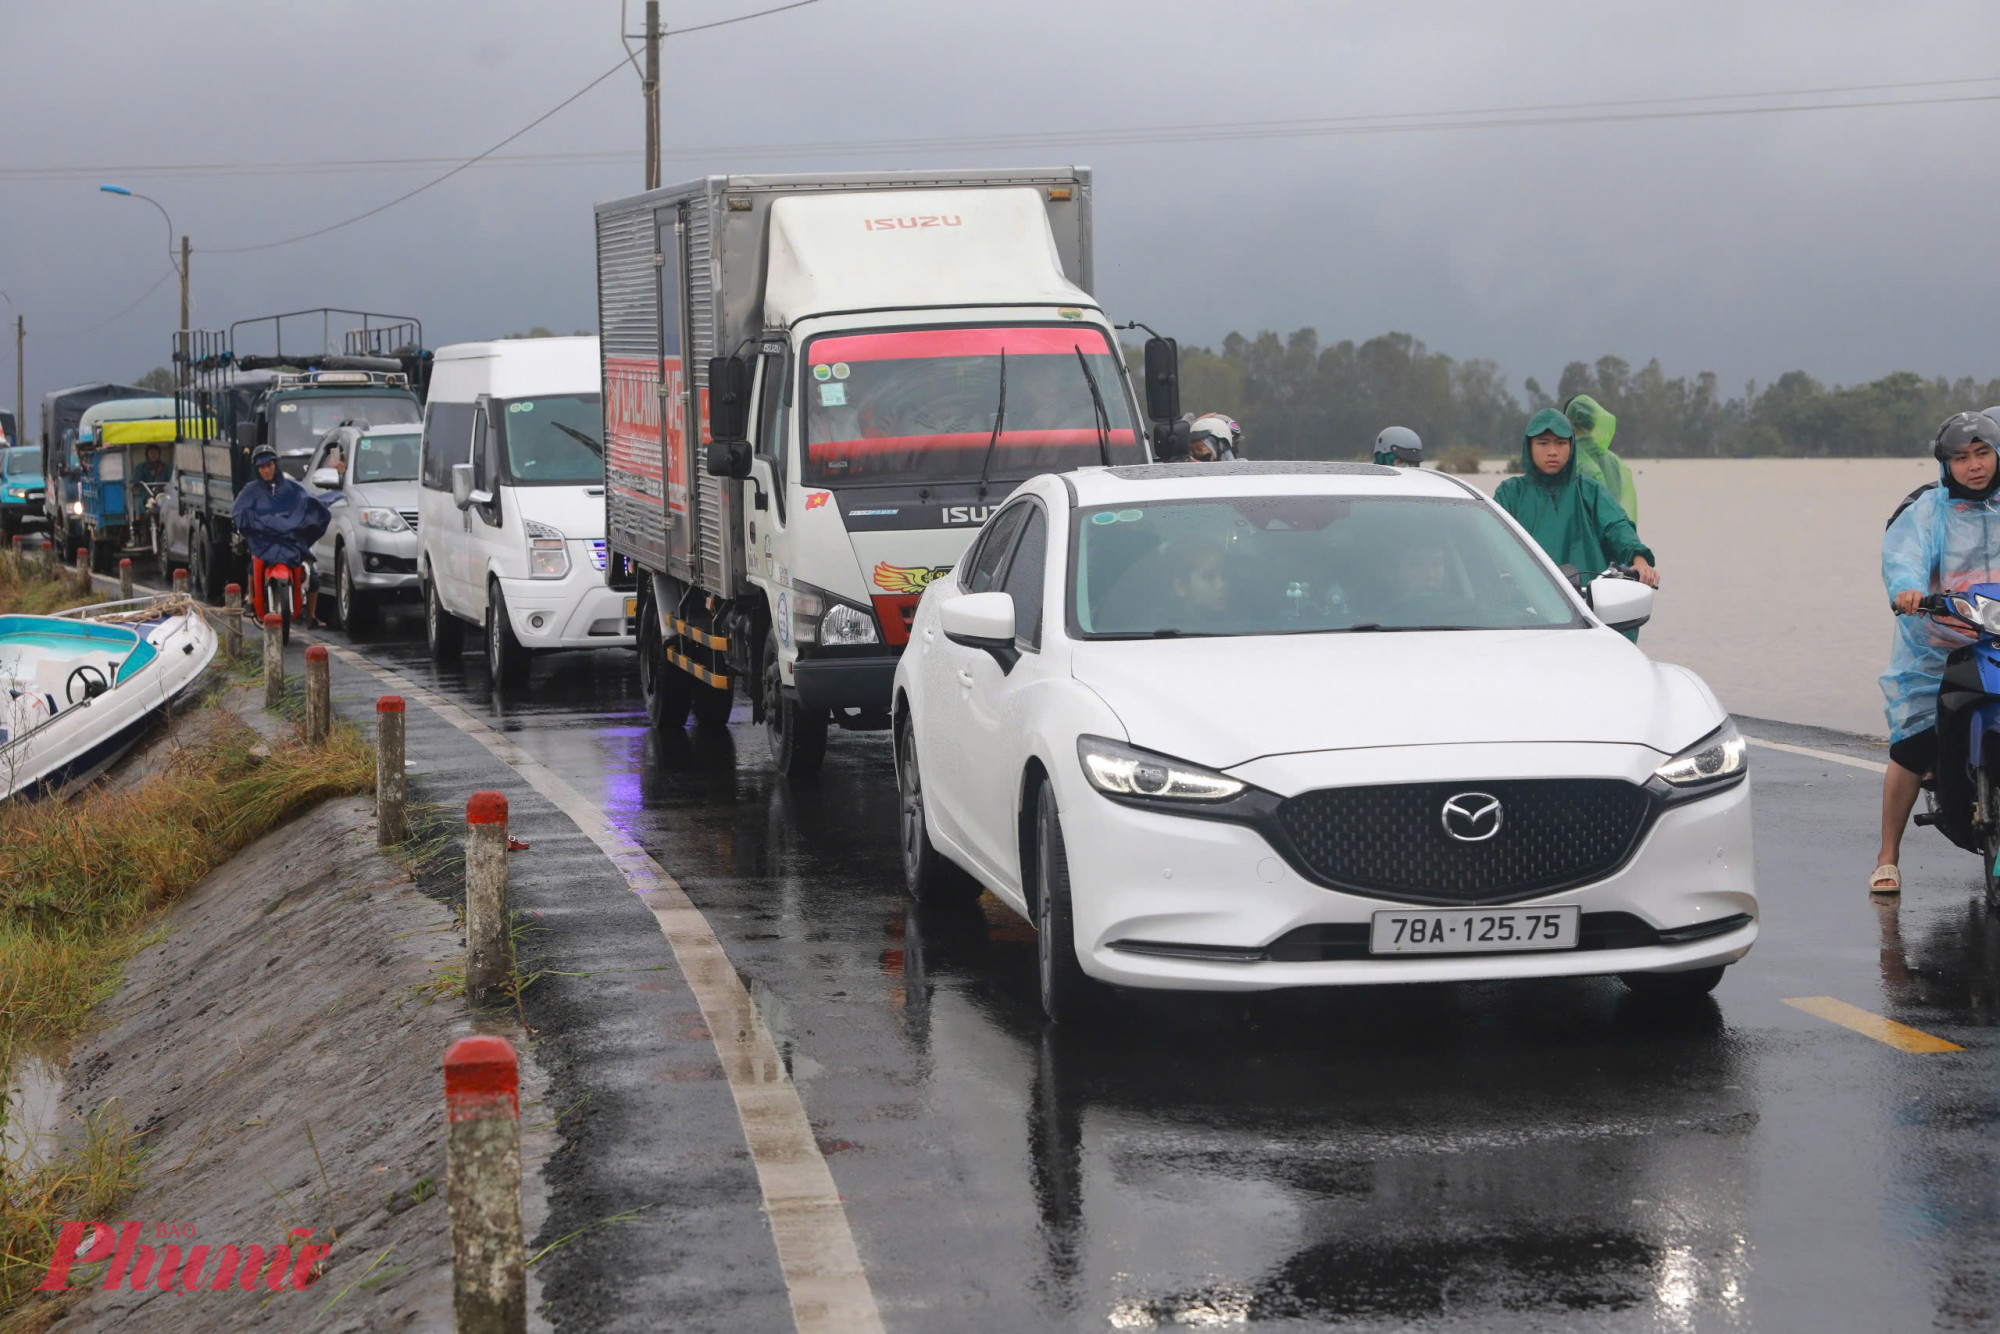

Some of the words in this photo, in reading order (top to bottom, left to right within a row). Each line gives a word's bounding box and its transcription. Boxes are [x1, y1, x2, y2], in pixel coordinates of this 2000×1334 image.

[864, 214, 962, 231] ISUZU
[621, 370, 682, 431] LALAMVE
[1391, 914, 1562, 944] 78A-125.75
